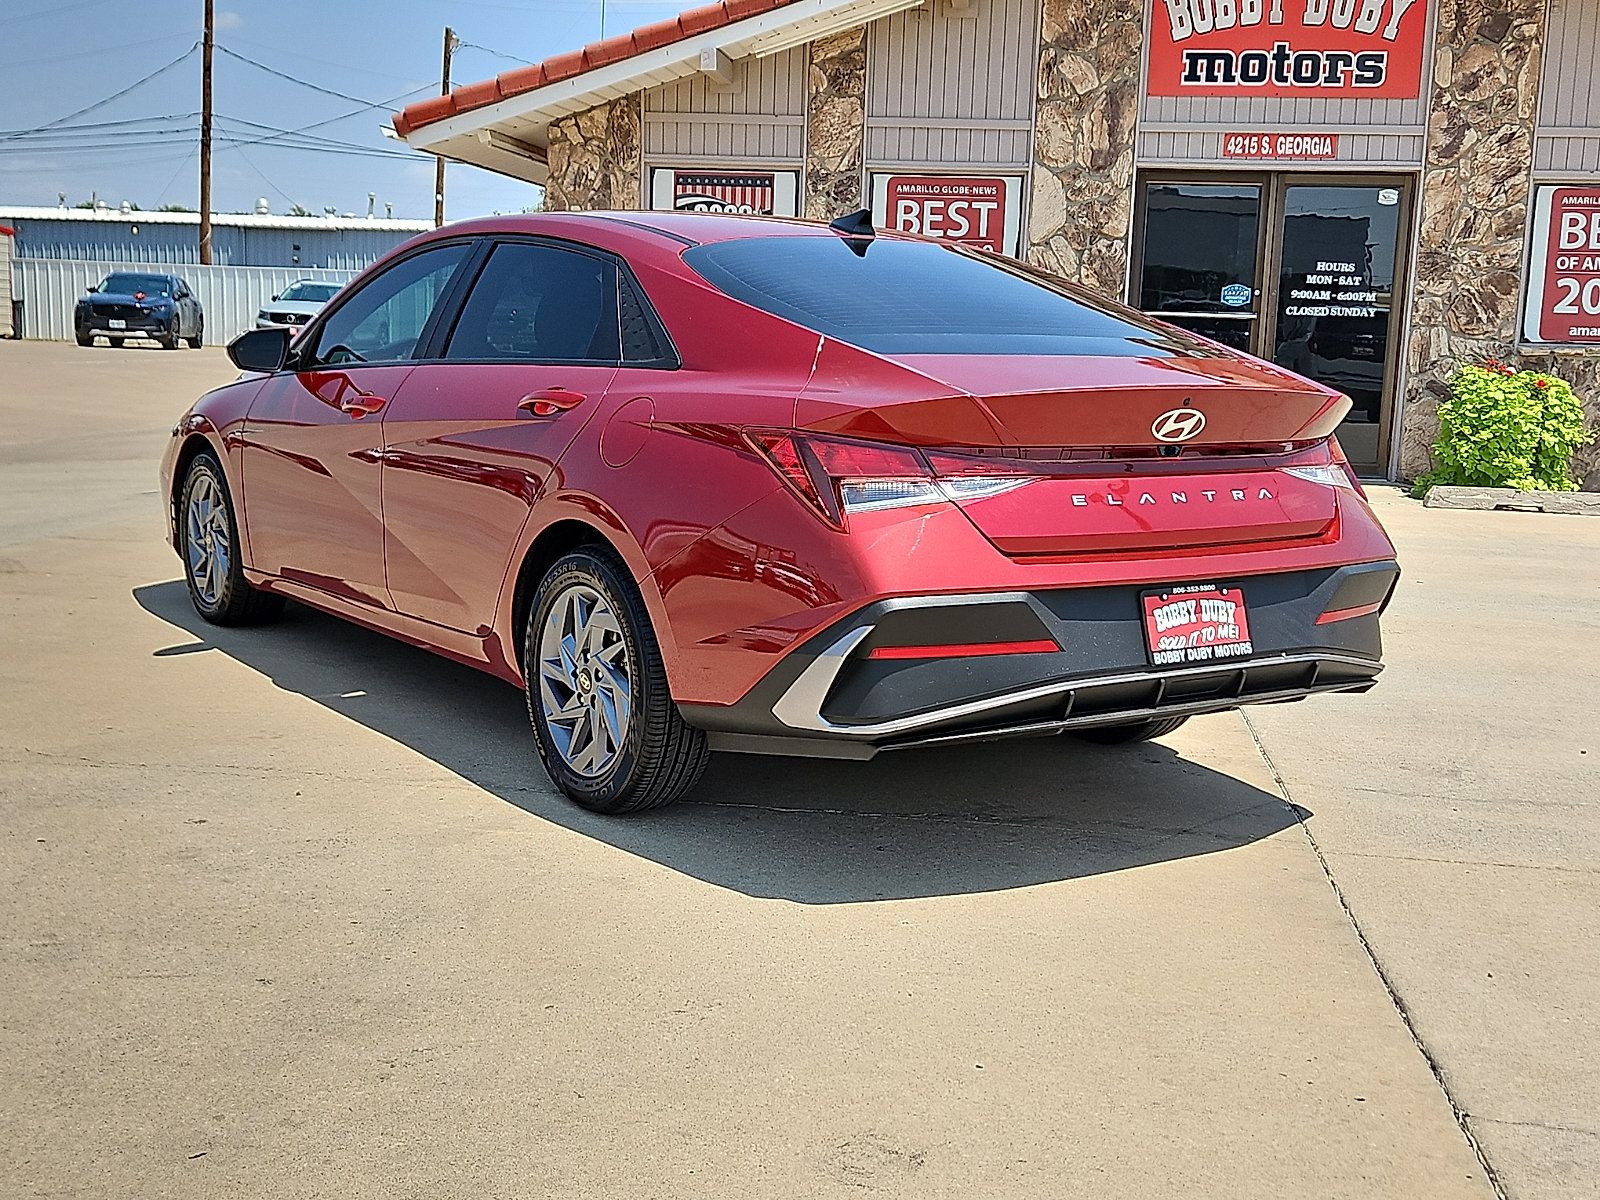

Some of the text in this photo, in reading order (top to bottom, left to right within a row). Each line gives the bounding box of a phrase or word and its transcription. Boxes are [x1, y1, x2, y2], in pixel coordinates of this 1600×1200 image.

[1180, 41, 1388, 88] motors
[1227, 136, 1332, 155] 4215 S. GEORGIA
[896, 184, 997, 195] AMARILLO GLOBE-NEWS
[896, 200, 998, 238] BEST
[1316, 261, 1356, 272] HOURS
[1556, 256, 1580, 270] OF
[1285, 306, 1376, 318] CLOSED SUNDAY
[1071, 488, 1273, 506] ELANTRA
[1153, 600, 1236, 632] BOBBY DUBY
[1157, 636, 1187, 650] SOLD
[1200, 626, 1216, 643] TO
[1218, 624, 1239, 640] ME!
[1153, 642, 1253, 665] BOBBY DUBY MOTORS
